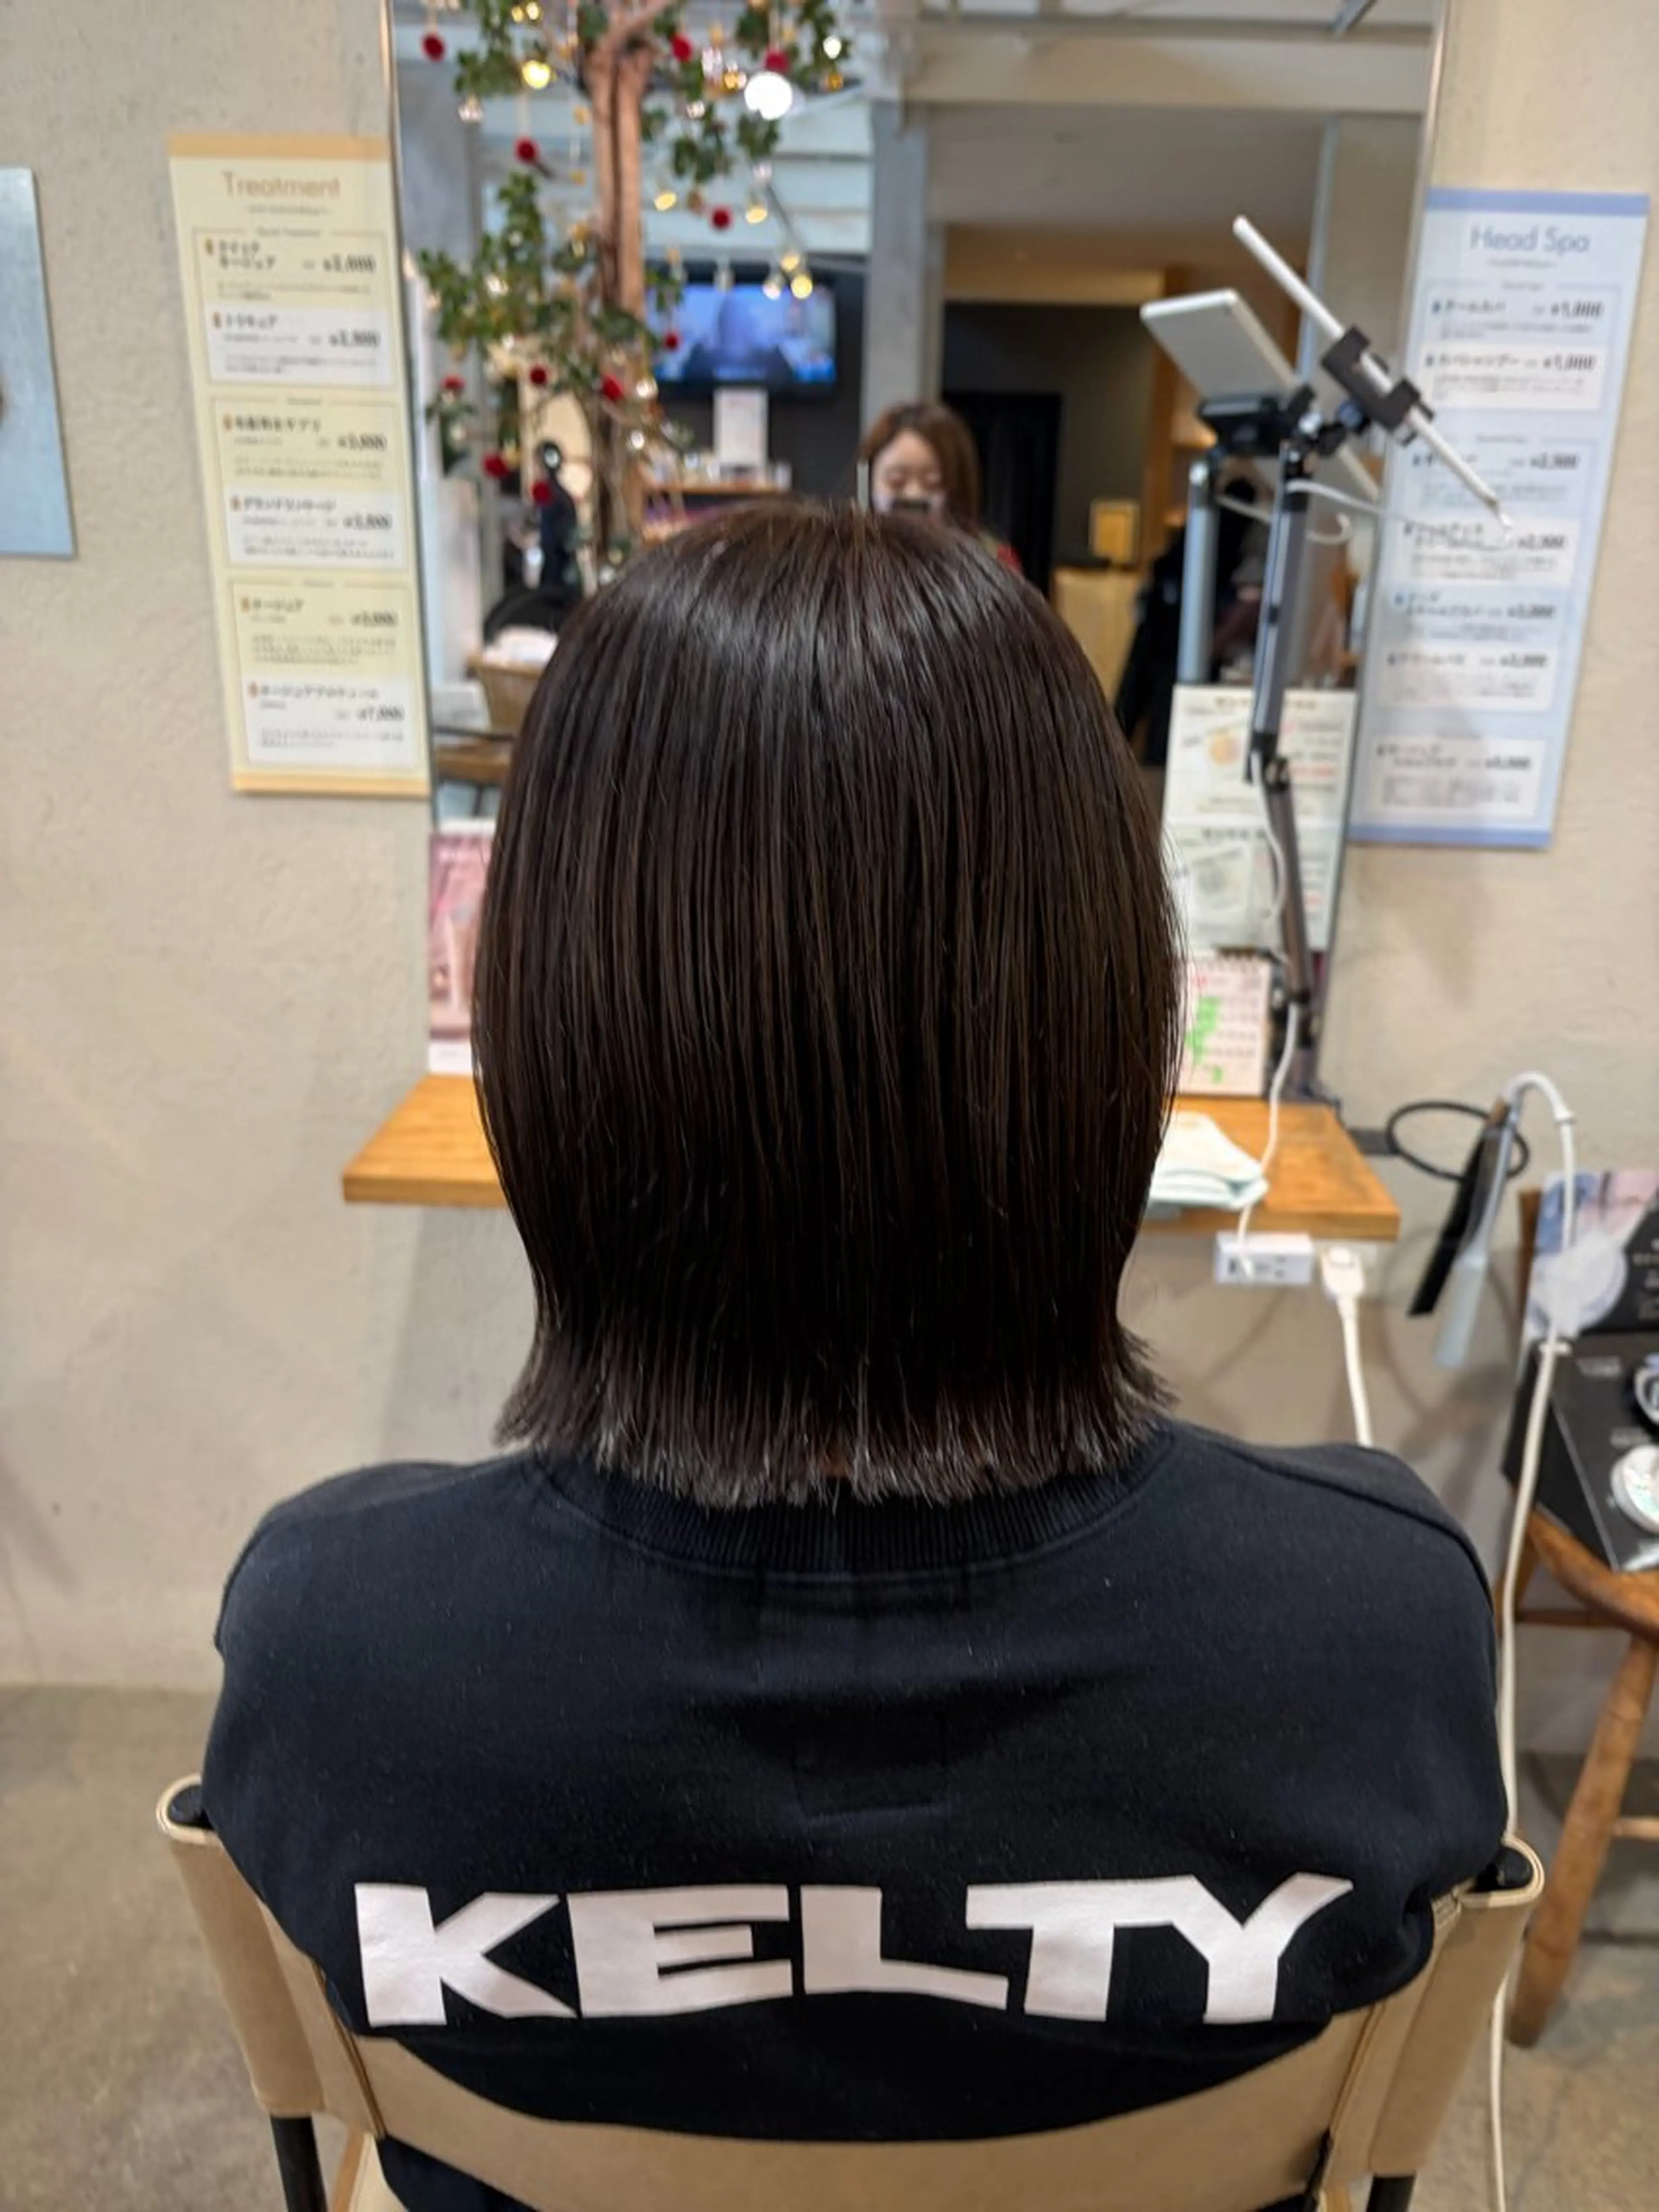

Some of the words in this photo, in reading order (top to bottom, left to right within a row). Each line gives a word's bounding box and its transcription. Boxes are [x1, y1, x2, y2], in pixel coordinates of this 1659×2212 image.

[222, 172, 340, 198] Treatment
[1470, 226, 1539, 251] Head
[1544, 226, 1591, 255] Spa
[355, 1874, 1352, 2026] KELTY
